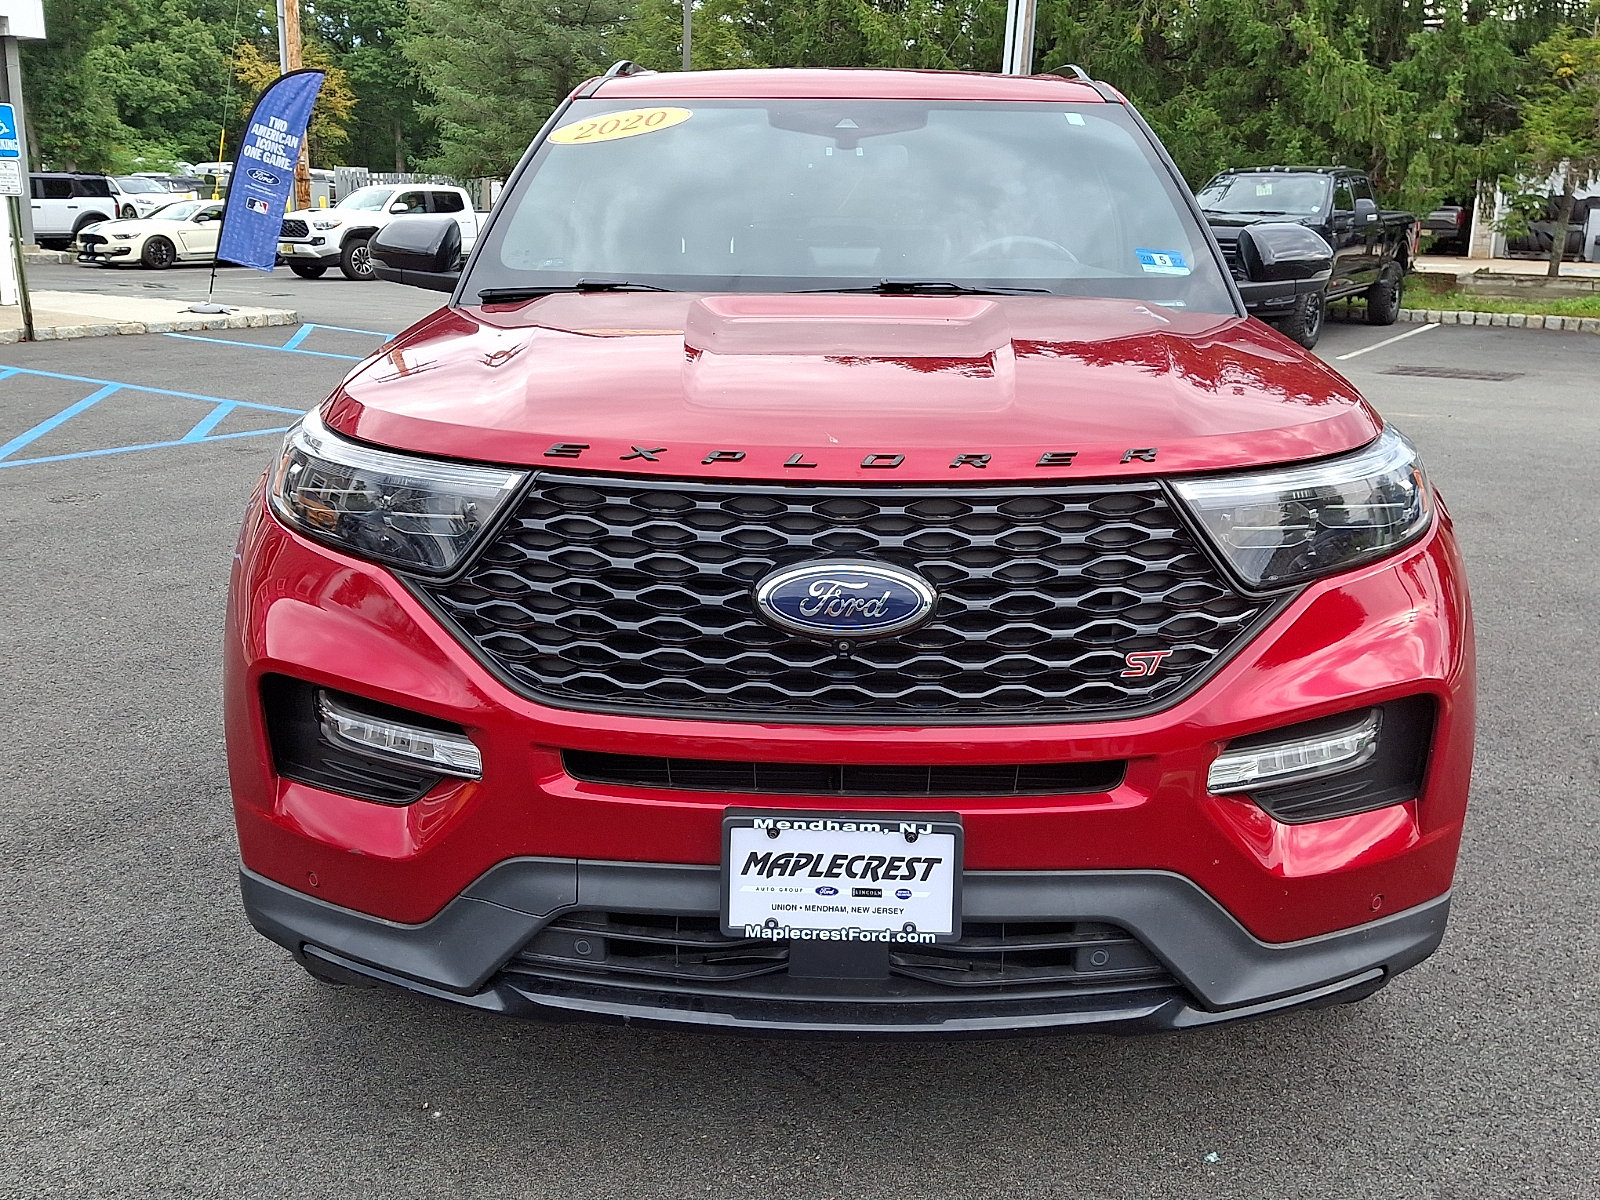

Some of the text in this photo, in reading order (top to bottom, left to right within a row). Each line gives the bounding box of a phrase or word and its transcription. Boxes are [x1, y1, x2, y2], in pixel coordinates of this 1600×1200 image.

[269, 116, 287, 132] TWO
[573, 111, 667, 140] 2020
[251, 123, 299, 148] AMERICAN
[255, 137, 286, 156] ICONS.
[243, 145, 293, 171] ONE GAME.
[252, 170, 275, 184] Ford
[1159, 256, 1167, 265] 5
[543, 442, 1160, 469] EXPLORER
[800, 579, 891, 618] Ford
[1120, 650, 1173, 677] ST
[753, 818, 933, 835] Mendham, NJ
[740, 851, 943, 882] MAPLECREST
[819, 887, 836, 895] Ford
[855, 889, 882, 897] LINCOLN
[771, 903, 798, 912] UNION
[804, 905, 849, 914] MENDHAM,
[871, 907, 905, 915] JERSEY
[745, 925, 936, 944] MaplecrestFord.com
